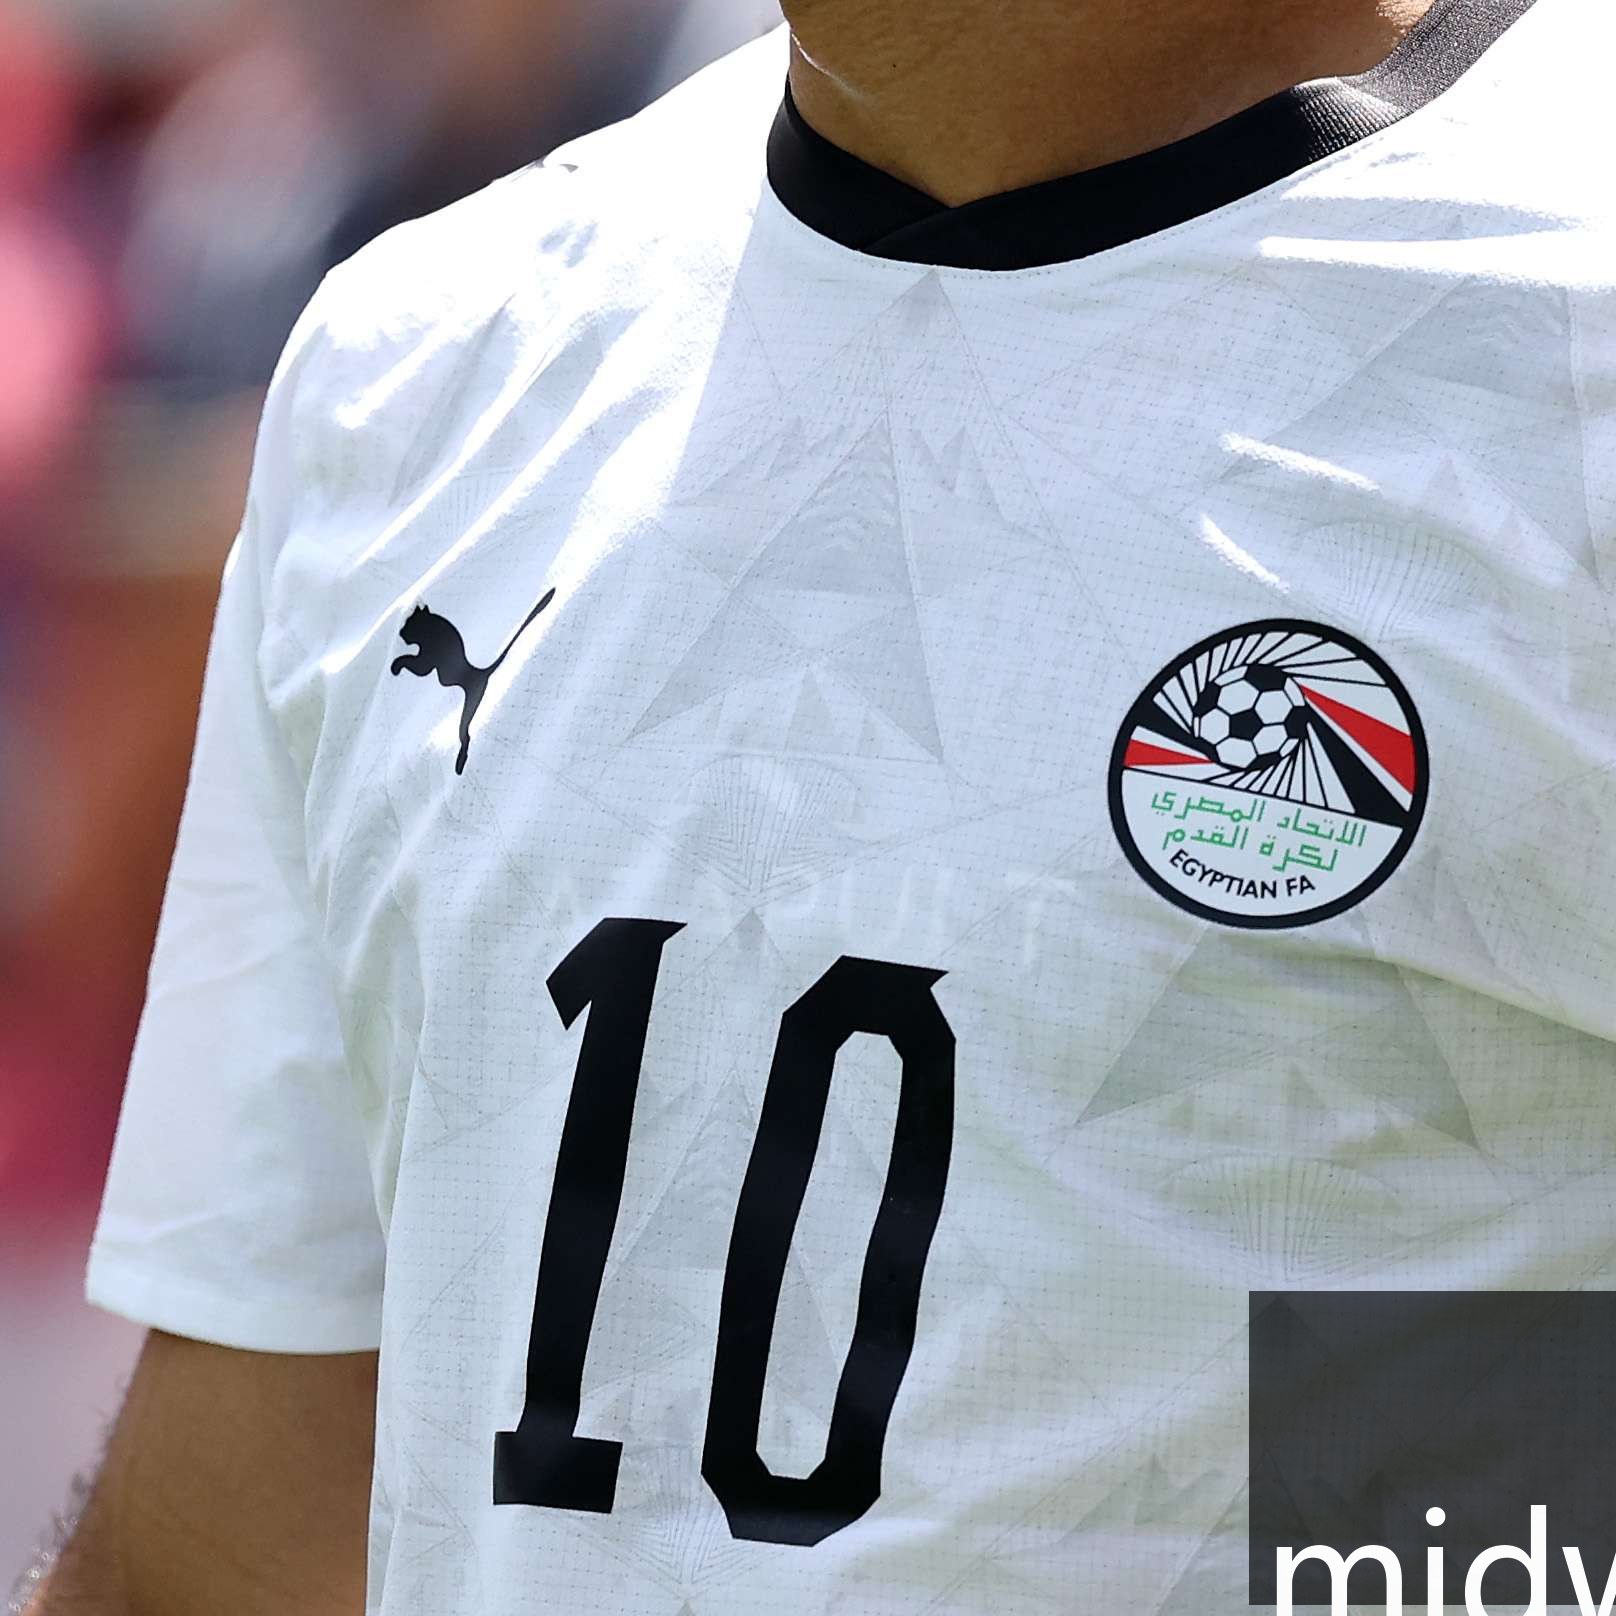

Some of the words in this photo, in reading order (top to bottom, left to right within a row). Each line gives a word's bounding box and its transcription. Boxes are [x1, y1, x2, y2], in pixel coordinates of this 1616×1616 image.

[1150, 791, 1266, 823] المصري
[1162, 824, 1250, 850] القدم
[1277, 808, 1367, 848] الاتحاد
[1259, 834, 1338, 873] لكرة
[1169, 848, 1278, 899] EGYPTIAN
[1286, 874, 1317, 897] FA
[492, 917, 957, 1547] 10
